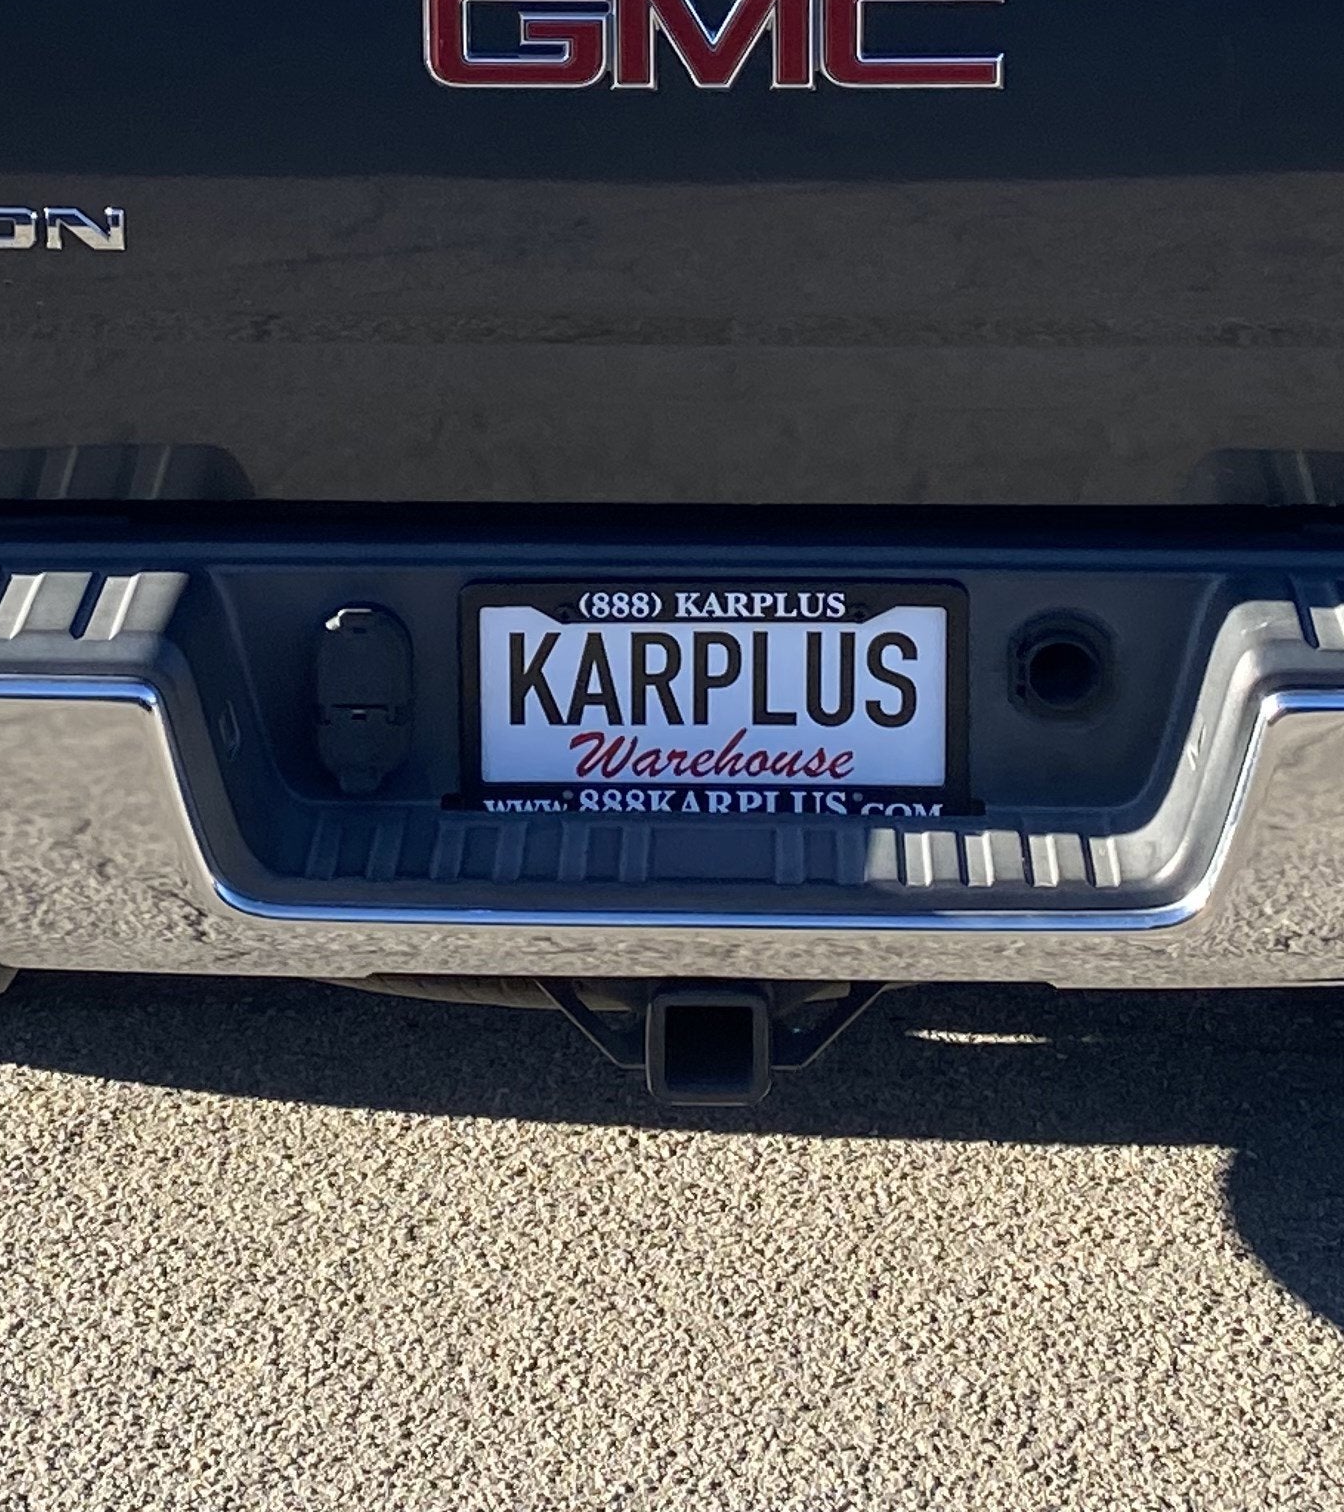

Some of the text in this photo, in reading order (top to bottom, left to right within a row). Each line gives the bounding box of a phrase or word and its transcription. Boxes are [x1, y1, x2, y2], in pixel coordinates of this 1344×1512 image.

[578, 591, 846, 619] (888) KARPLUS
[509, 631, 918, 728] KARPLUS
[569, 727, 855, 779] Warehouse
